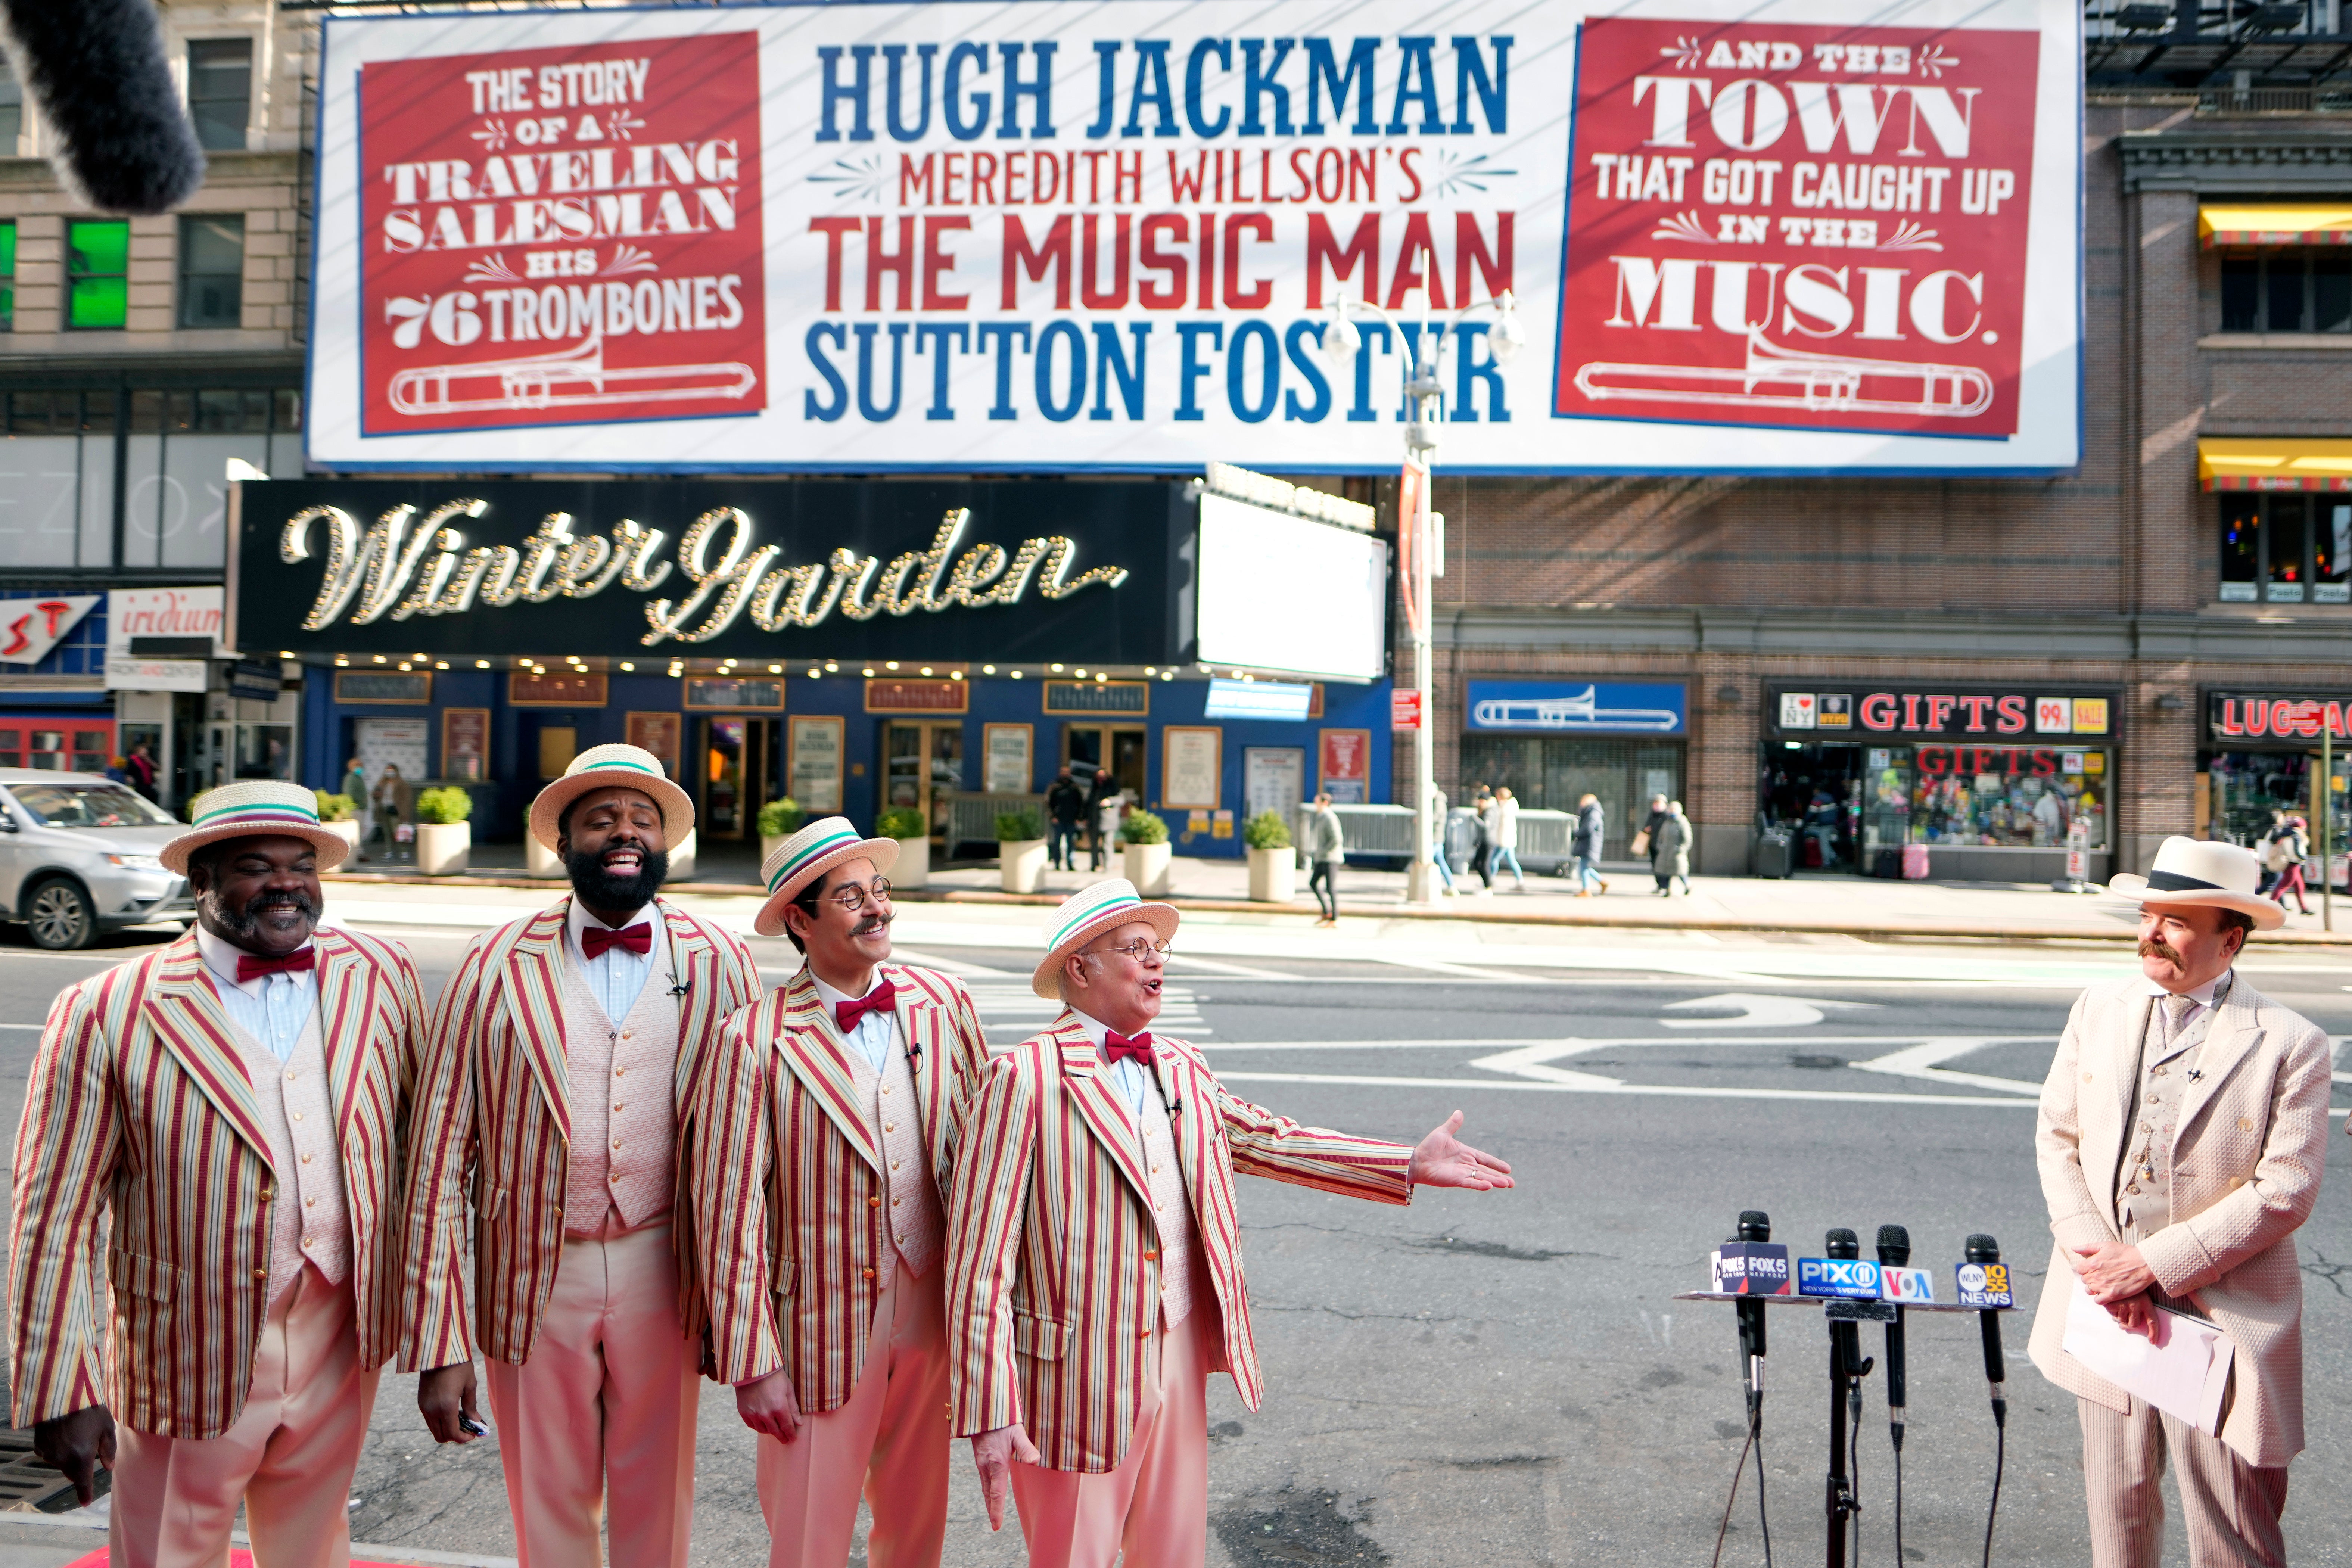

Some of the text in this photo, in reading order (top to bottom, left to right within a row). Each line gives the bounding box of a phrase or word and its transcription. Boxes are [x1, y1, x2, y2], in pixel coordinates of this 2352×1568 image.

[1706, 40, 1911, 74] AND THE
[466, 58, 650, 114] THE STORY
[816, 35, 1514, 142] HUGH JACKMAN
[515, 114, 604, 146] OF A
[1633, 75, 1982, 158] TOWN
[383, 139, 740, 205] TRAVELING
[899, 146, 1423, 206] MEREDITH WILLSON'S
[1591, 152, 2015, 215] THAT GOT CAUGHT UP
[383, 186, 740, 254] SALESMAN
[1718, 214, 1878, 249] IN THE
[525, 250, 598, 279] HIS
[809, 211, 1515, 311] THE MUSIC MAN
[385, 274, 743, 349] 76 TROMBONES
[1604, 255, 1999, 345] MUSIC.
[805, 320, 1151, 423] SUTTON
[281, 498, 1128, 646] Winter Garden
[1786, 711, 1810, 723] NY
[1860, 693, 2027, 734] GIFTS
[2077, 706, 2103, 724] SALE
[1917, 747, 2056, 777] GIFTS
[1802, 1262, 1853, 1284] PIX
[1885, 1271, 1931, 1299] VOA
[1961, 1273, 1983, 1282] WLNY
[1984, 1264, 2006, 1279] 10
[1985, 1278, 2009, 1292] 55
[1960, 1292, 2011, 1304] NEWS
